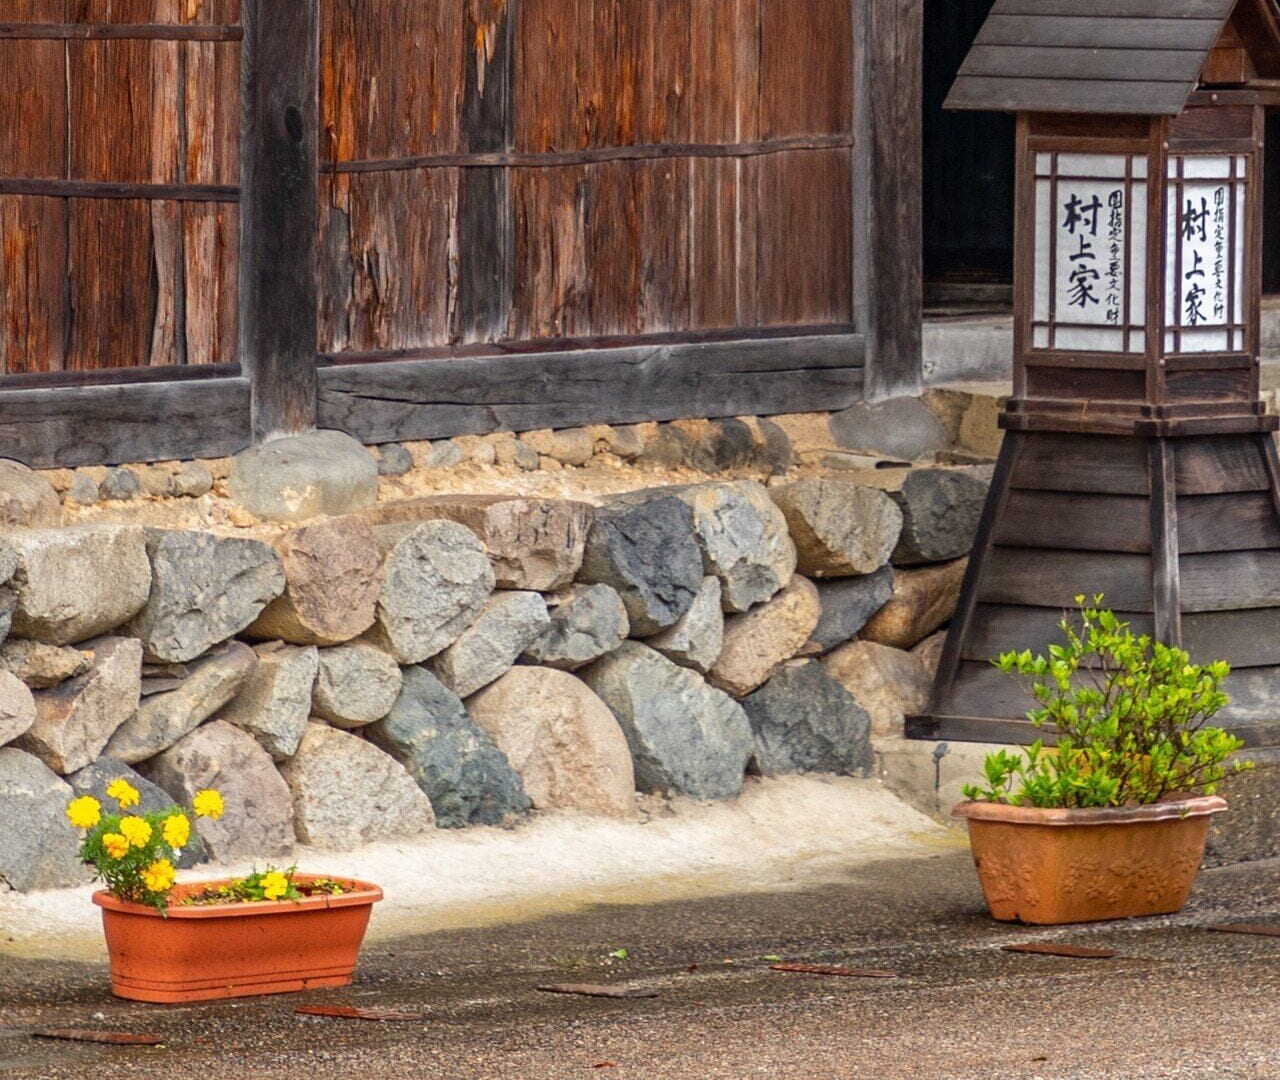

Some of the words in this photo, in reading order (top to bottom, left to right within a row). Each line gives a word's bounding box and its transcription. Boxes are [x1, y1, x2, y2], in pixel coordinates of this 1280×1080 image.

[1062, 193, 1103, 309] 村上家
[1181, 197, 1210, 326] 村上家
